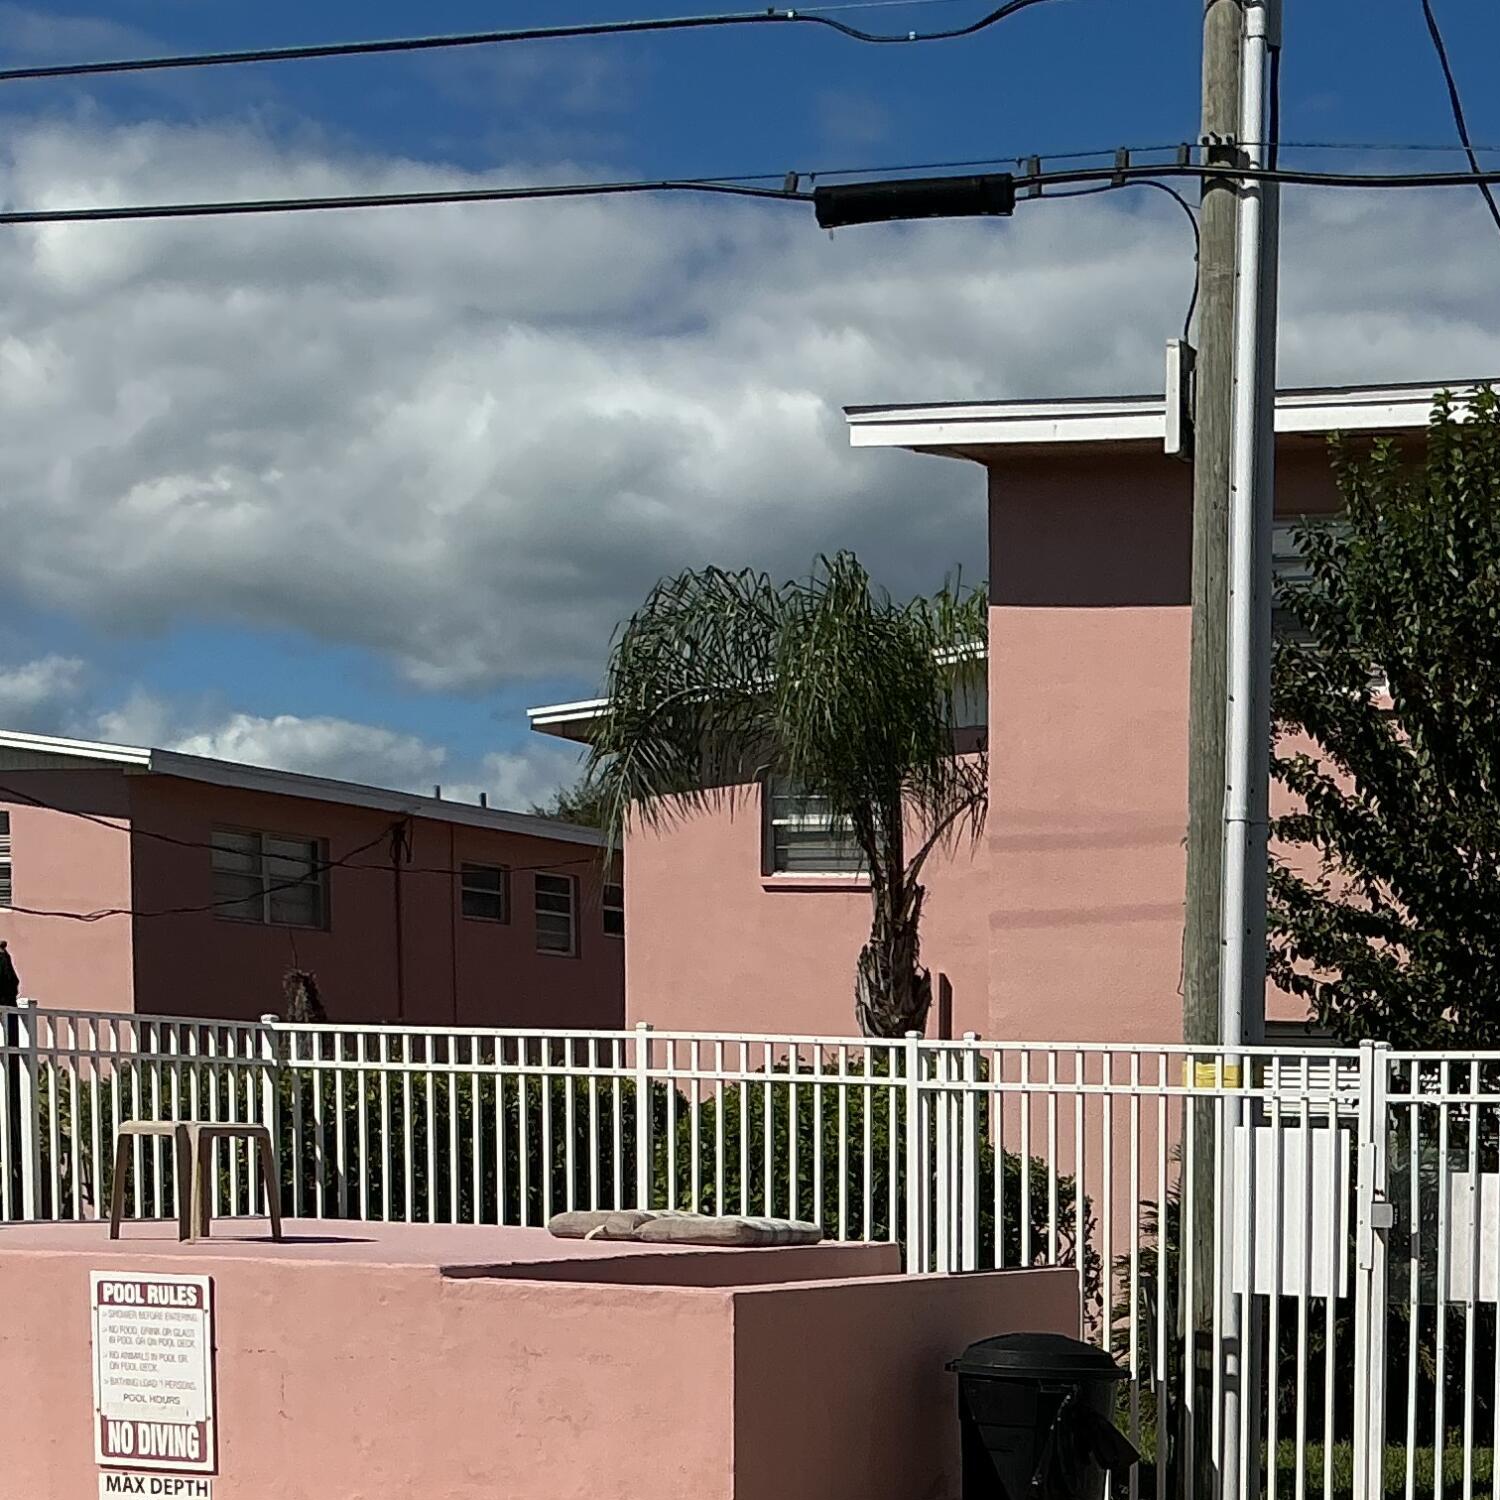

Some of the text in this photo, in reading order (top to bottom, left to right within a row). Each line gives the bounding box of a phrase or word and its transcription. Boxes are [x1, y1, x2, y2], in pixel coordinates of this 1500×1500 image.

[102, 1283, 197, 1306] POOL RULES
[123, 1393, 181, 1405] POOL HOURS
[107, 1421, 200, 1459] NO DIVING
[106, 1475, 208, 1497] MAX DEPTH
